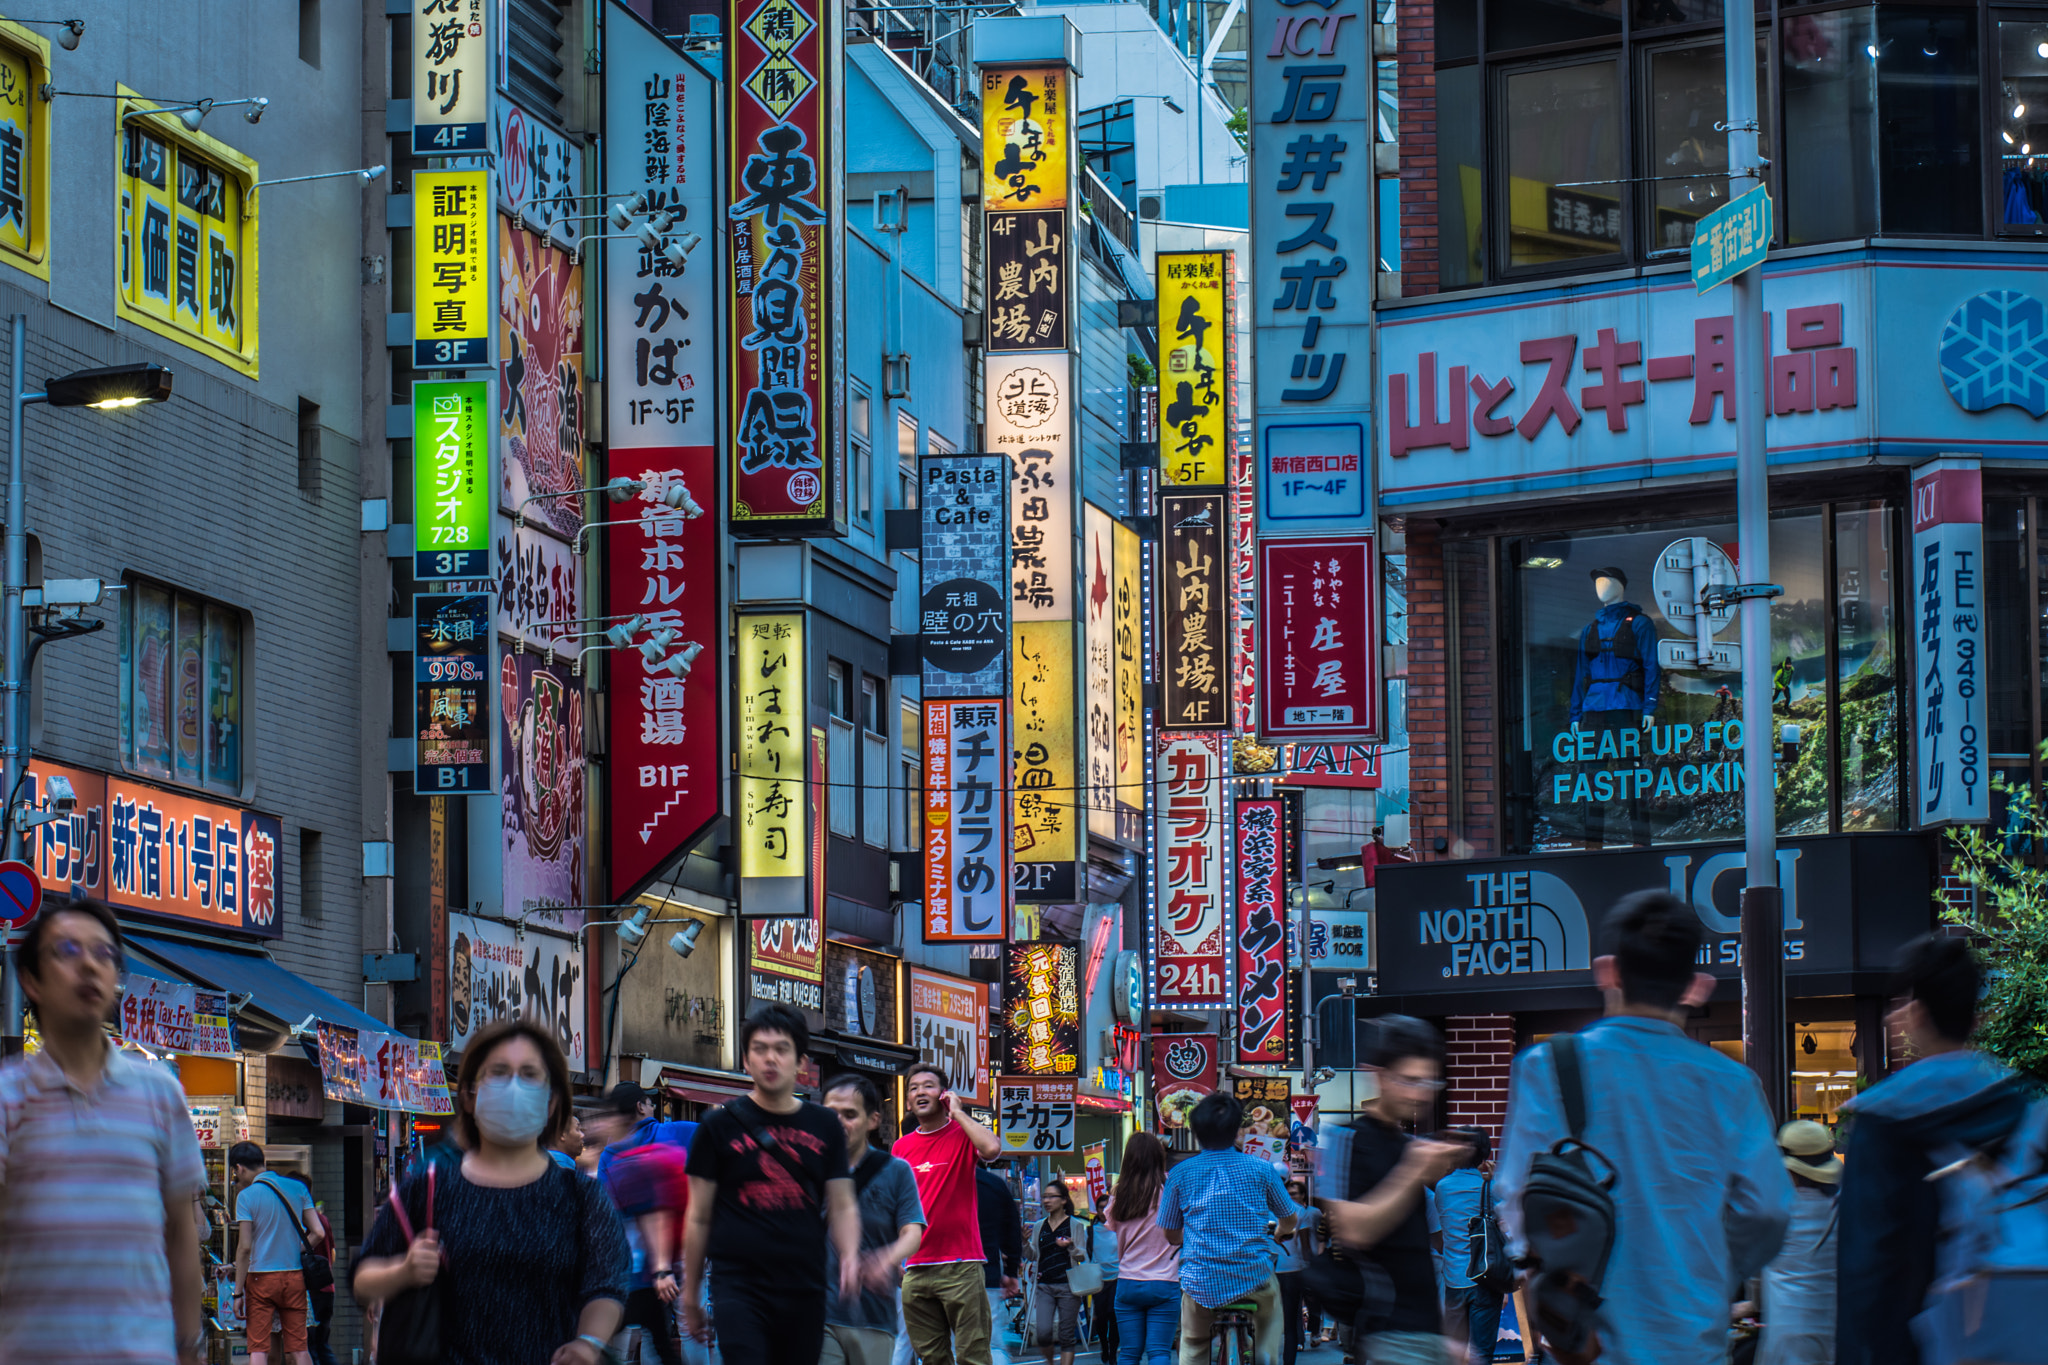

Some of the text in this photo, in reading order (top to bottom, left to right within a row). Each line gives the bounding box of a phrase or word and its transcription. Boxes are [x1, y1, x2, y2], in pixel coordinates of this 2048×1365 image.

[987, 75, 1002, 90] 5F
[1043, 75, 1057, 115] 居楽屋
[433, 126, 467, 147] 4F
[644, 73, 671, 184] 山陰海鮮
[992, 217, 1016, 235] 4F
[1271, 65, 1347, 401] 石井スポーツ
[433, 185, 466, 332] 証明写真
[1025, 218, 1060, 294] 山内
[1167, 264, 1214, 279] 居楽屋
[992, 261, 1031, 343] 農場
[435, 341, 468, 361] 3F
[1389, 303, 1857, 457] 山とスキー用品
[435, 417, 461, 523] スタジオ
[929, 468, 996, 485] Pasta
[1180, 462, 1205, 482] 5F
[1272, 456, 1357, 474] 新宿西口店
[956, 489, 969, 505] &
[1915, 480, 1940, 525] ICI
[936, 507, 990, 525] Cafe
[431, 526, 469, 543] 728
[436, 553, 469, 574] 3F
[1954, 551, 1973, 608] TEL
[946, 592, 977, 607] 元祖
[1313, 560, 1325, 607] さかな
[1329, 558, 1343, 608] 串やき
[431, 620, 474, 641] 水園
[752, 622, 791, 640] 廻転
[922, 609, 1003, 635] 壁の穴
[1175, 539, 1215, 693] 山内農場
[1310, 617, 1346, 697] 庄屋
[1921, 542, 1944, 814] 石井スポーツ
[431, 697, 472, 730] 風車
[930, 705, 946, 734] 元祖
[954, 706, 997, 729] 東京
[1182, 701, 1210, 722] 4F
[1293, 708, 1345, 723] 地下一階
[424, 749, 483, 764] 完全個室
[756, 650, 793, 861] ひまわり寿司
[1553, 727, 1640, 763] GEAR
[1652, 723, 1692, 756] UP
[438, 767, 469, 788] B1
[639, 765, 689, 787] B1F
[929, 738, 947, 808] 焼き牛丼
[1553, 761, 1778, 804] FASTPACKIN
[957, 730, 995, 932] チカラめし
[1122, 808, 1136, 842] 2F
[1168, 749, 1213, 934] カラオケ
[111, 793, 239, 915] 新宿11号店
[1241, 807, 1276, 904] 横浜家系
[249, 831, 275, 926] 薬
[930, 829, 948, 934] スタミナ定食
[1014, 864, 1056, 890] 2F
[1466, 871, 1528, 907] THE
[1420, 906, 1530, 944] NORTH
[1452, 940, 1532, 977] FACE
[751, 974, 778, 1001] Welcome!
[1160, 964, 1222, 995] 24h
[1240, 905, 1282, 1052] ラーメン
[124, 994, 157, 1044] 免税
[1029, 948, 1054, 1069] 元気回復堂
[1057, 1062, 1075, 1071] B1F
[1002, 1088, 1030, 1101] 東京
[1294, 1100, 1313, 1108] 止まれ
[1002, 1103, 1074, 1129] チカラ
[1033, 1130, 1073, 1150] めし
